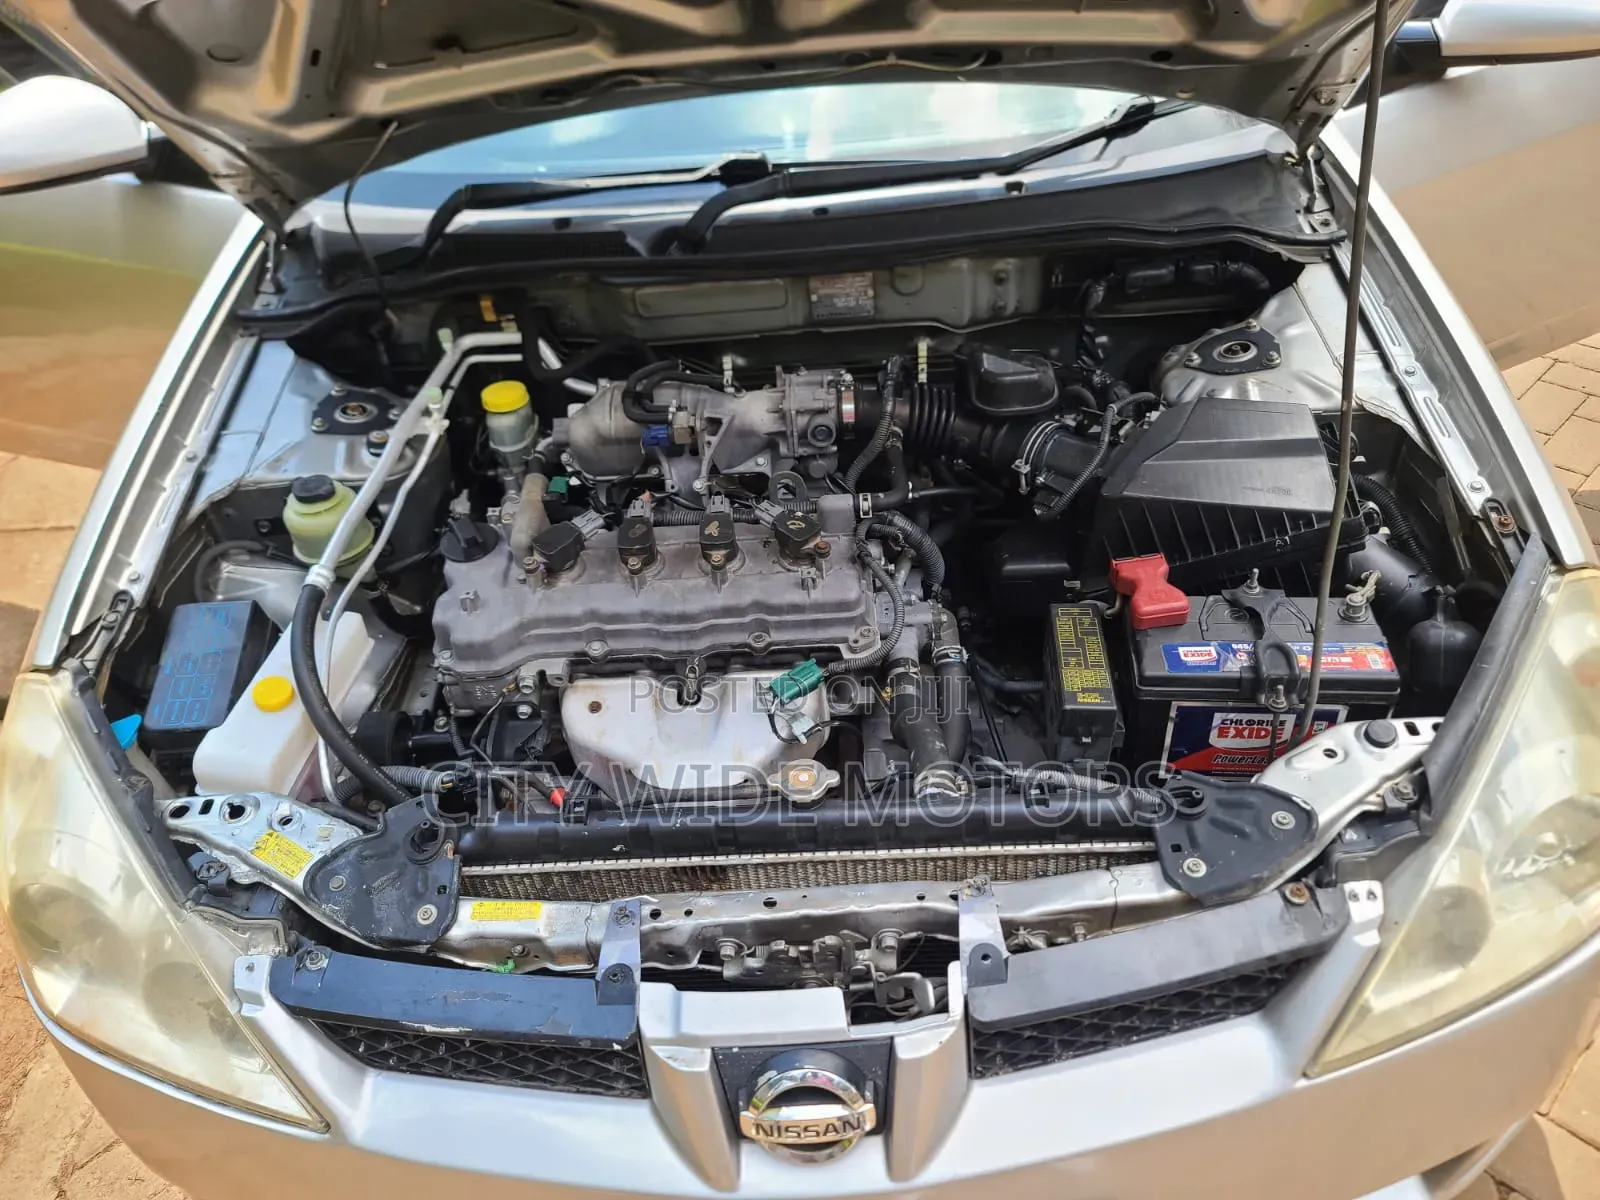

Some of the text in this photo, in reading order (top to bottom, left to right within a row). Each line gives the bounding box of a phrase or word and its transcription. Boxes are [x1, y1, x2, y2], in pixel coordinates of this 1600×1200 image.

[1219, 718, 1287, 727] CHLORIE
[1216, 727, 1285, 740] EXIDE
[753, 1116, 862, 1138] NISSAN
